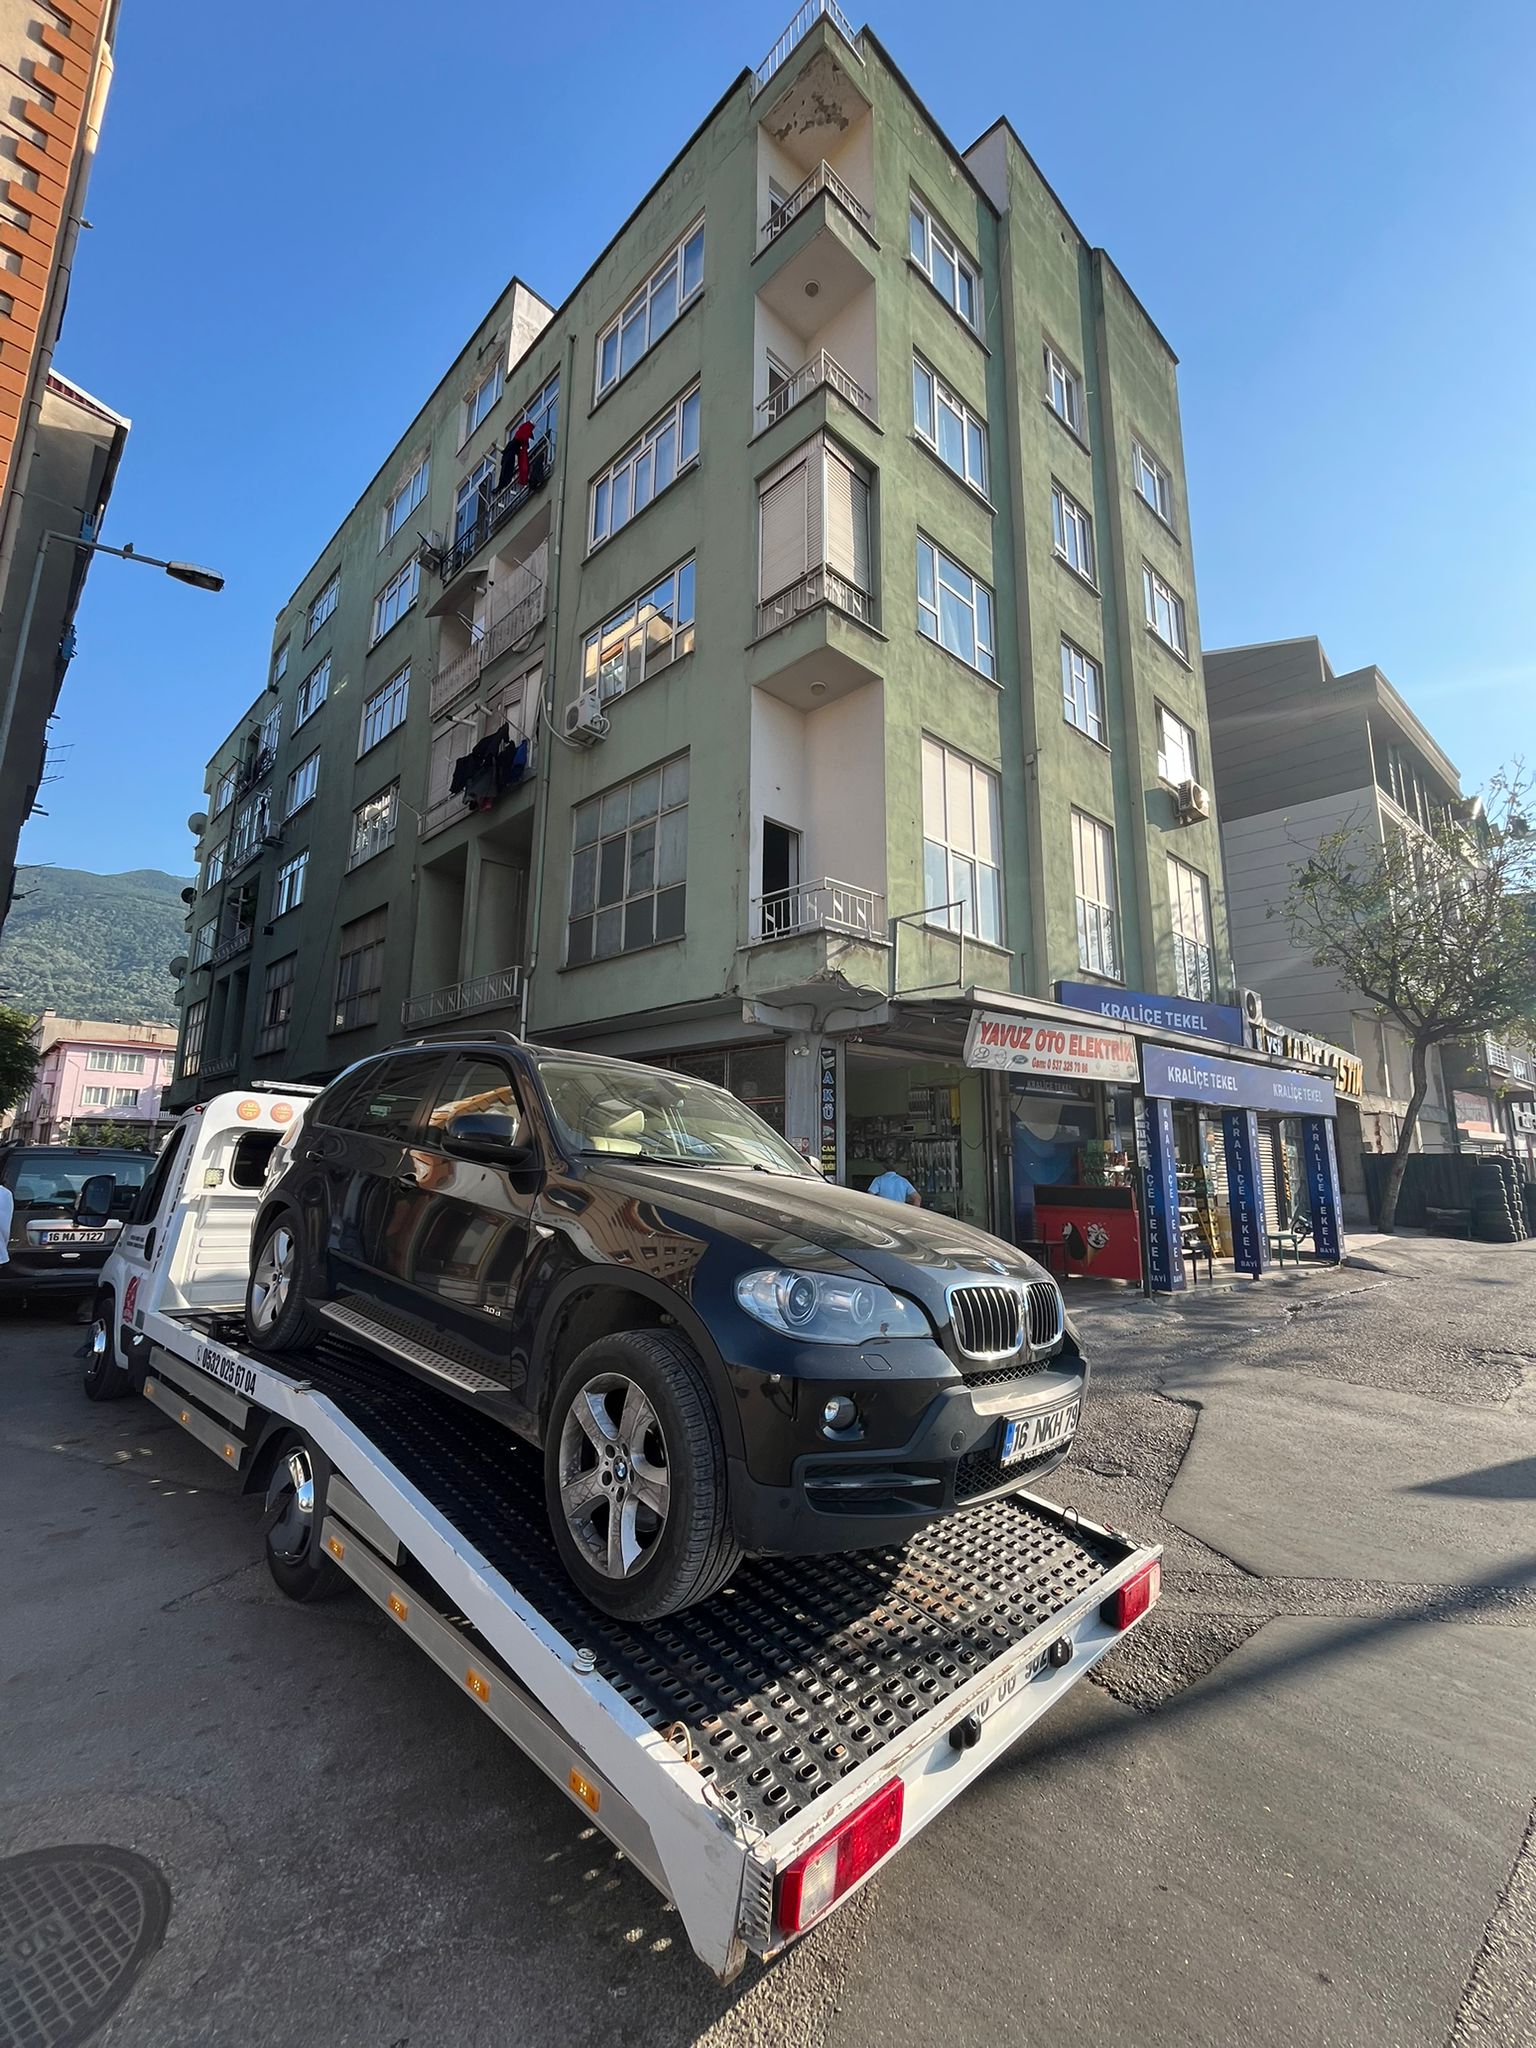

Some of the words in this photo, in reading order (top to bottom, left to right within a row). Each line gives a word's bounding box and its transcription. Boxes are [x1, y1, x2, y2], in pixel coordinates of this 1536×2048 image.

[1101, 1002, 1162, 1025] KRALİÇE
[1165, 1011, 1208, 1031] TEKEL
[980, 1021, 1033, 1050] YAVUZ
[1035, 1028, 1066, 1054] OTO
[1069, 1033, 1135, 1063] ELEKTRİK
[822, 1070, 835, 1120] AKÜ
[1168, 1066, 1209, 1090] KRALİÇE
[1210, 1072, 1239, 1092] TEKEL
[1272, 1082, 1302, 1104] KRALİÇE
[1302, 1088, 1324, 1103] TEKEL
[1162, 1107, 1175, 1199] KRALİÇE
[1170, 1205, 1181, 1273] TEKEL
[1231, 1116, 1246, 1196] KRALİÇE
[1240, 1201, 1252, 1259] TEKEL
[1311, 1123, 1326, 1192] KRALİÇE
[1319, 1196, 1331, 1246] TEKEL
[48, 1232, 60, 1242] 16
[61, 1232, 76, 1242] MA
[79, 1232, 104, 1242] 7127
[1148, 1205, 1161, 1272] TEKEL
[202, 1347, 221, 1376] 0532
[220, 1356, 236, 1383] 025
[234, 1364, 246, 1389] 67
[244, 1369, 257, 1396] 04
[1012, 1421, 1030, 1453] 16
[1032, 1410, 1064, 1446] NKH
[1064, 1403, 1079, 1433] 79
